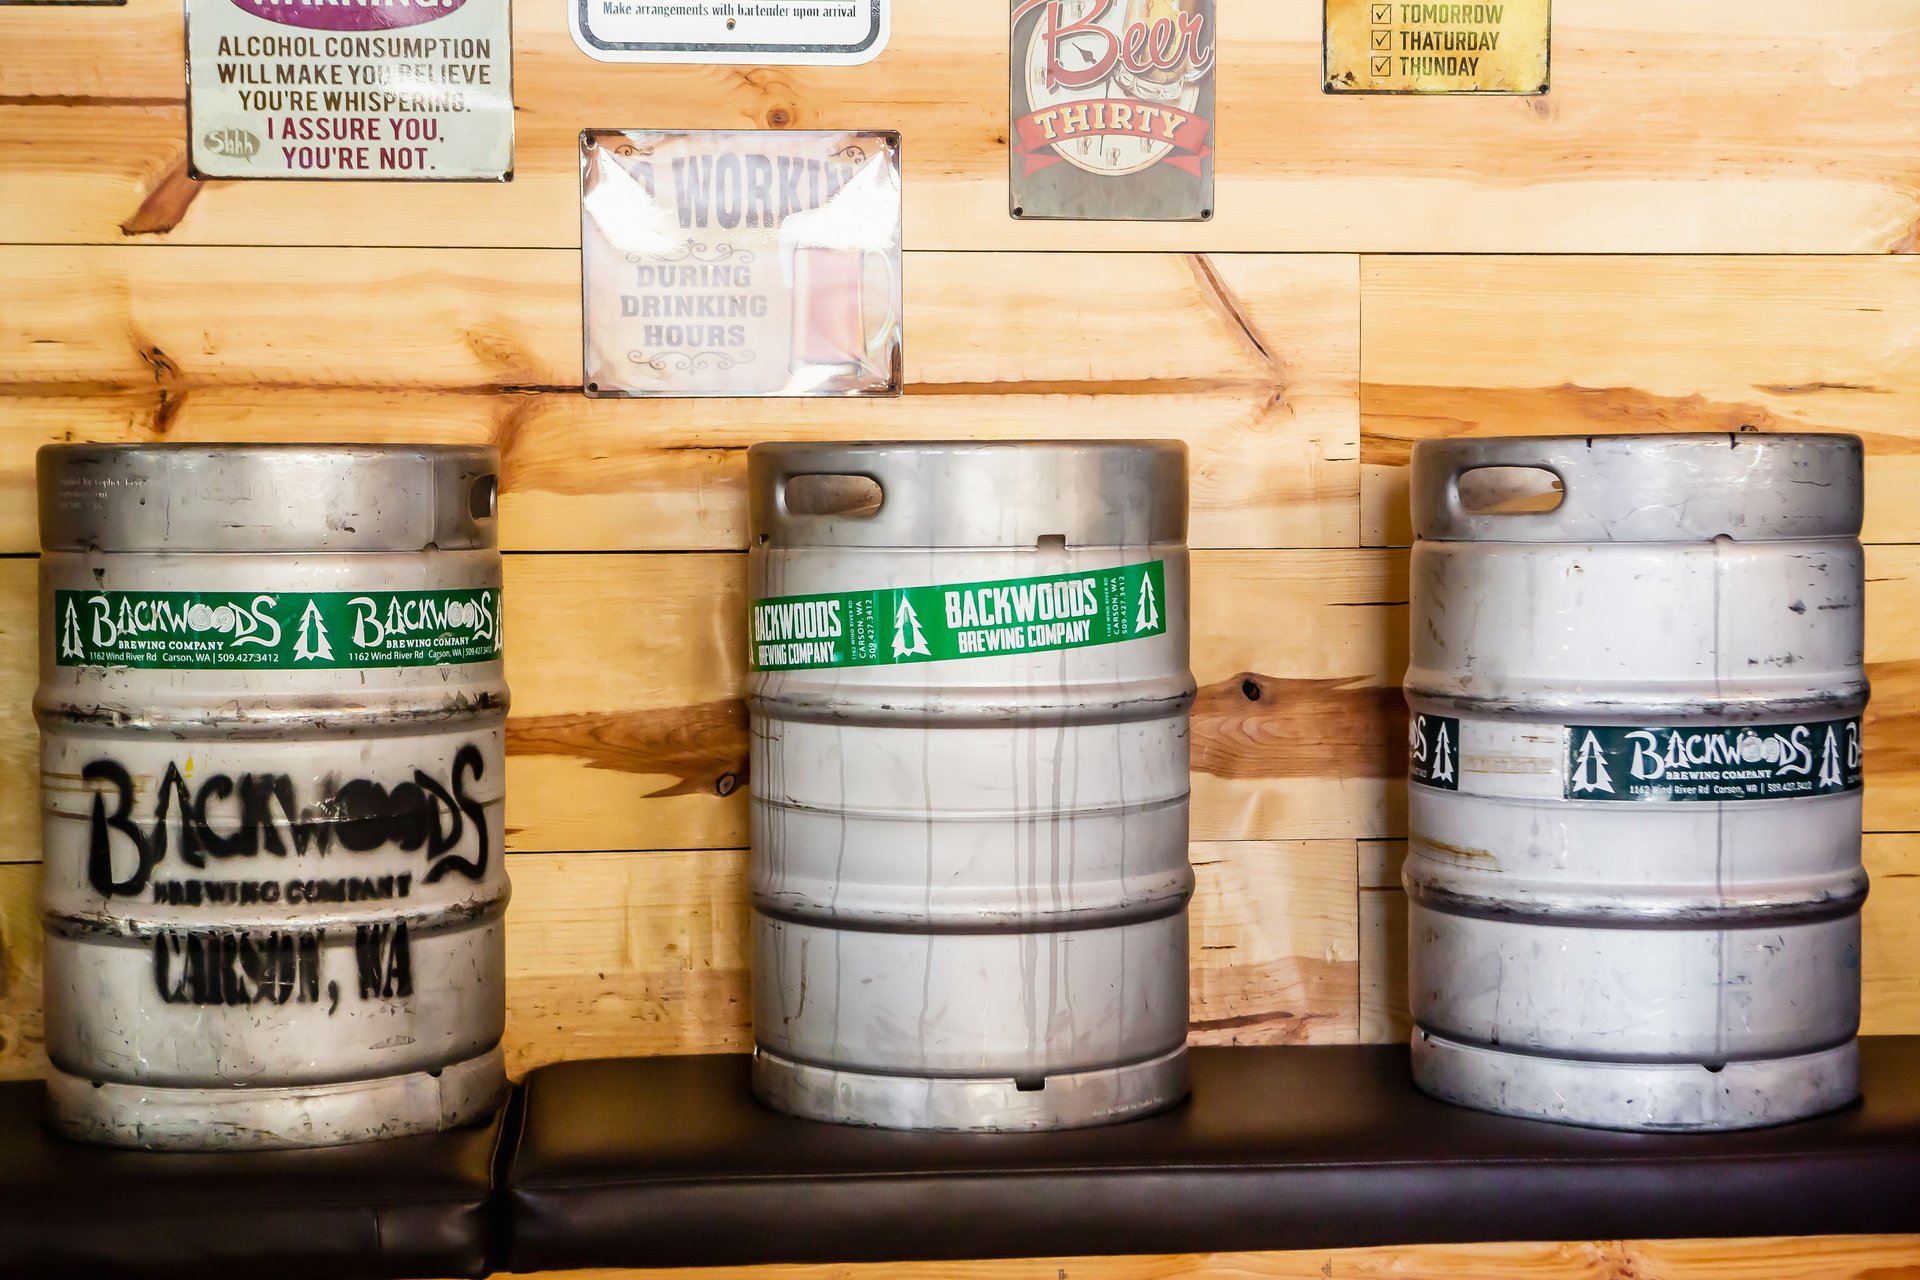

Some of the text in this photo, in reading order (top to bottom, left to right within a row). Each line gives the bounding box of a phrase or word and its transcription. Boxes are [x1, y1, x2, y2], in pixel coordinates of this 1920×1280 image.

[603, 2, 857, 19] Make arrangements with bartender upon arrival
[1400, 4, 1504, 24] TOMORROW
[218, 36, 491, 59] ALCOHOL CONSUMPTION
[1012, 0, 1211, 89] Beer
[1400, 31, 1500, 51] THATURDAY
[217, 63, 491, 85] WILL MAKE YOU BELIEVE
[1399, 57, 1480, 77] THUNDAY
[238, 90, 472, 112] YOU'RE WHISPERING.
[267, 117, 445, 143] I ASSURE YOU,
[1034, 103, 1186, 140] THIRTY
[208, 126, 254, 155] Shhh
[281, 146, 436, 170] YOU'RE NOT.
[636, 265, 751, 289] DURING
[620, 294, 768, 319] DRINKING
[643, 323, 746, 348] HOURS
[945, 577, 1098, 629] BACKWOODS
[1110, 577, 1120, 635] CARSON, WA
[1118, 575, 1127, 634] 509.427.3412
[88, 595, 281, 647] BACKWOODS
[347, 591, 493, 648] BACKWOODS
[755, 600, 842, 641] BACKWOODS
[856, 600, 867, 659] CARSON, WA
[865, 599, 877, 659] 509.427.3412
[118, 640, 224, 650] BREWING COMPANY
[386, 636, 470, 649] BREWING COMPANY
[957, 619, 1091, 653] BREWING COMPANY
[90, 652, 279, 663] 1162 Wind River Rd Carson, WA 509.427.3412
[349, 652, 369, 661] 1162
[370, 651, 392, 660] Wind
[394, 651, 413, 660] River
[414, 651, 424, 660] Rd
[428, 649, 451, 659] Carson,
[452, 650, 462, 658] WA
[788, 641, 835, 665] COMPANY
[1624, 725, 1813, 780] BACKWOODS
[1665, 769, 1773, 780] BREWING COMPANY
[1674, 785, 1697, 794] River
[1698, 785, 1710, 794] Rd
[82, 744, 489, 898] BACKWOODS
